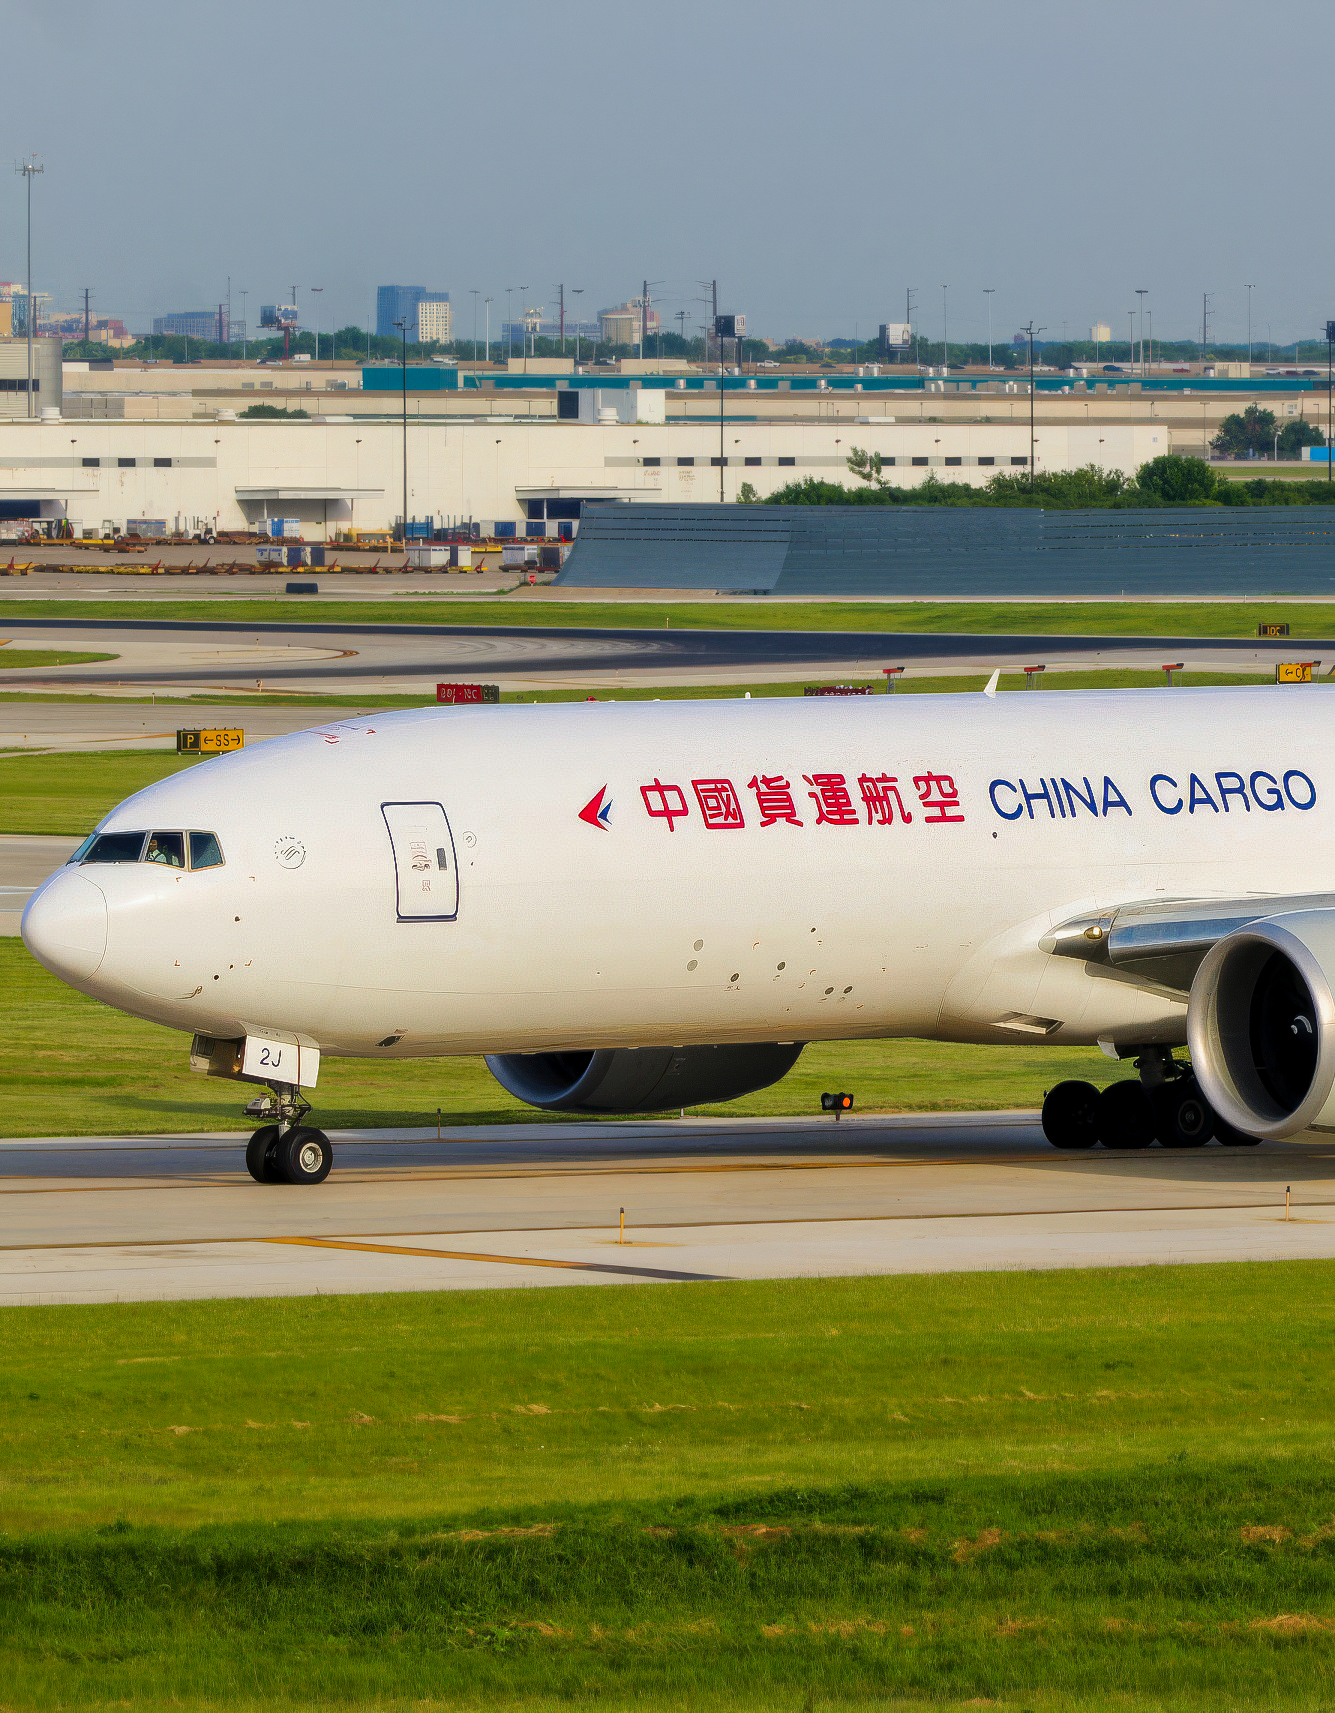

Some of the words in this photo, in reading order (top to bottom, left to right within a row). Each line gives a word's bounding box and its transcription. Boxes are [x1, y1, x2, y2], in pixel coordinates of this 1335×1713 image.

[187, 734, 195, 749] P
[215, 733, 230, 747] SS
[639, 770, 966, 832] 中國貨運航空
[988, 776, 1133, 821] CHINA
[1149, 769, 1317, 815] CARGO
[259, 1047, 282, 1068] 2J
